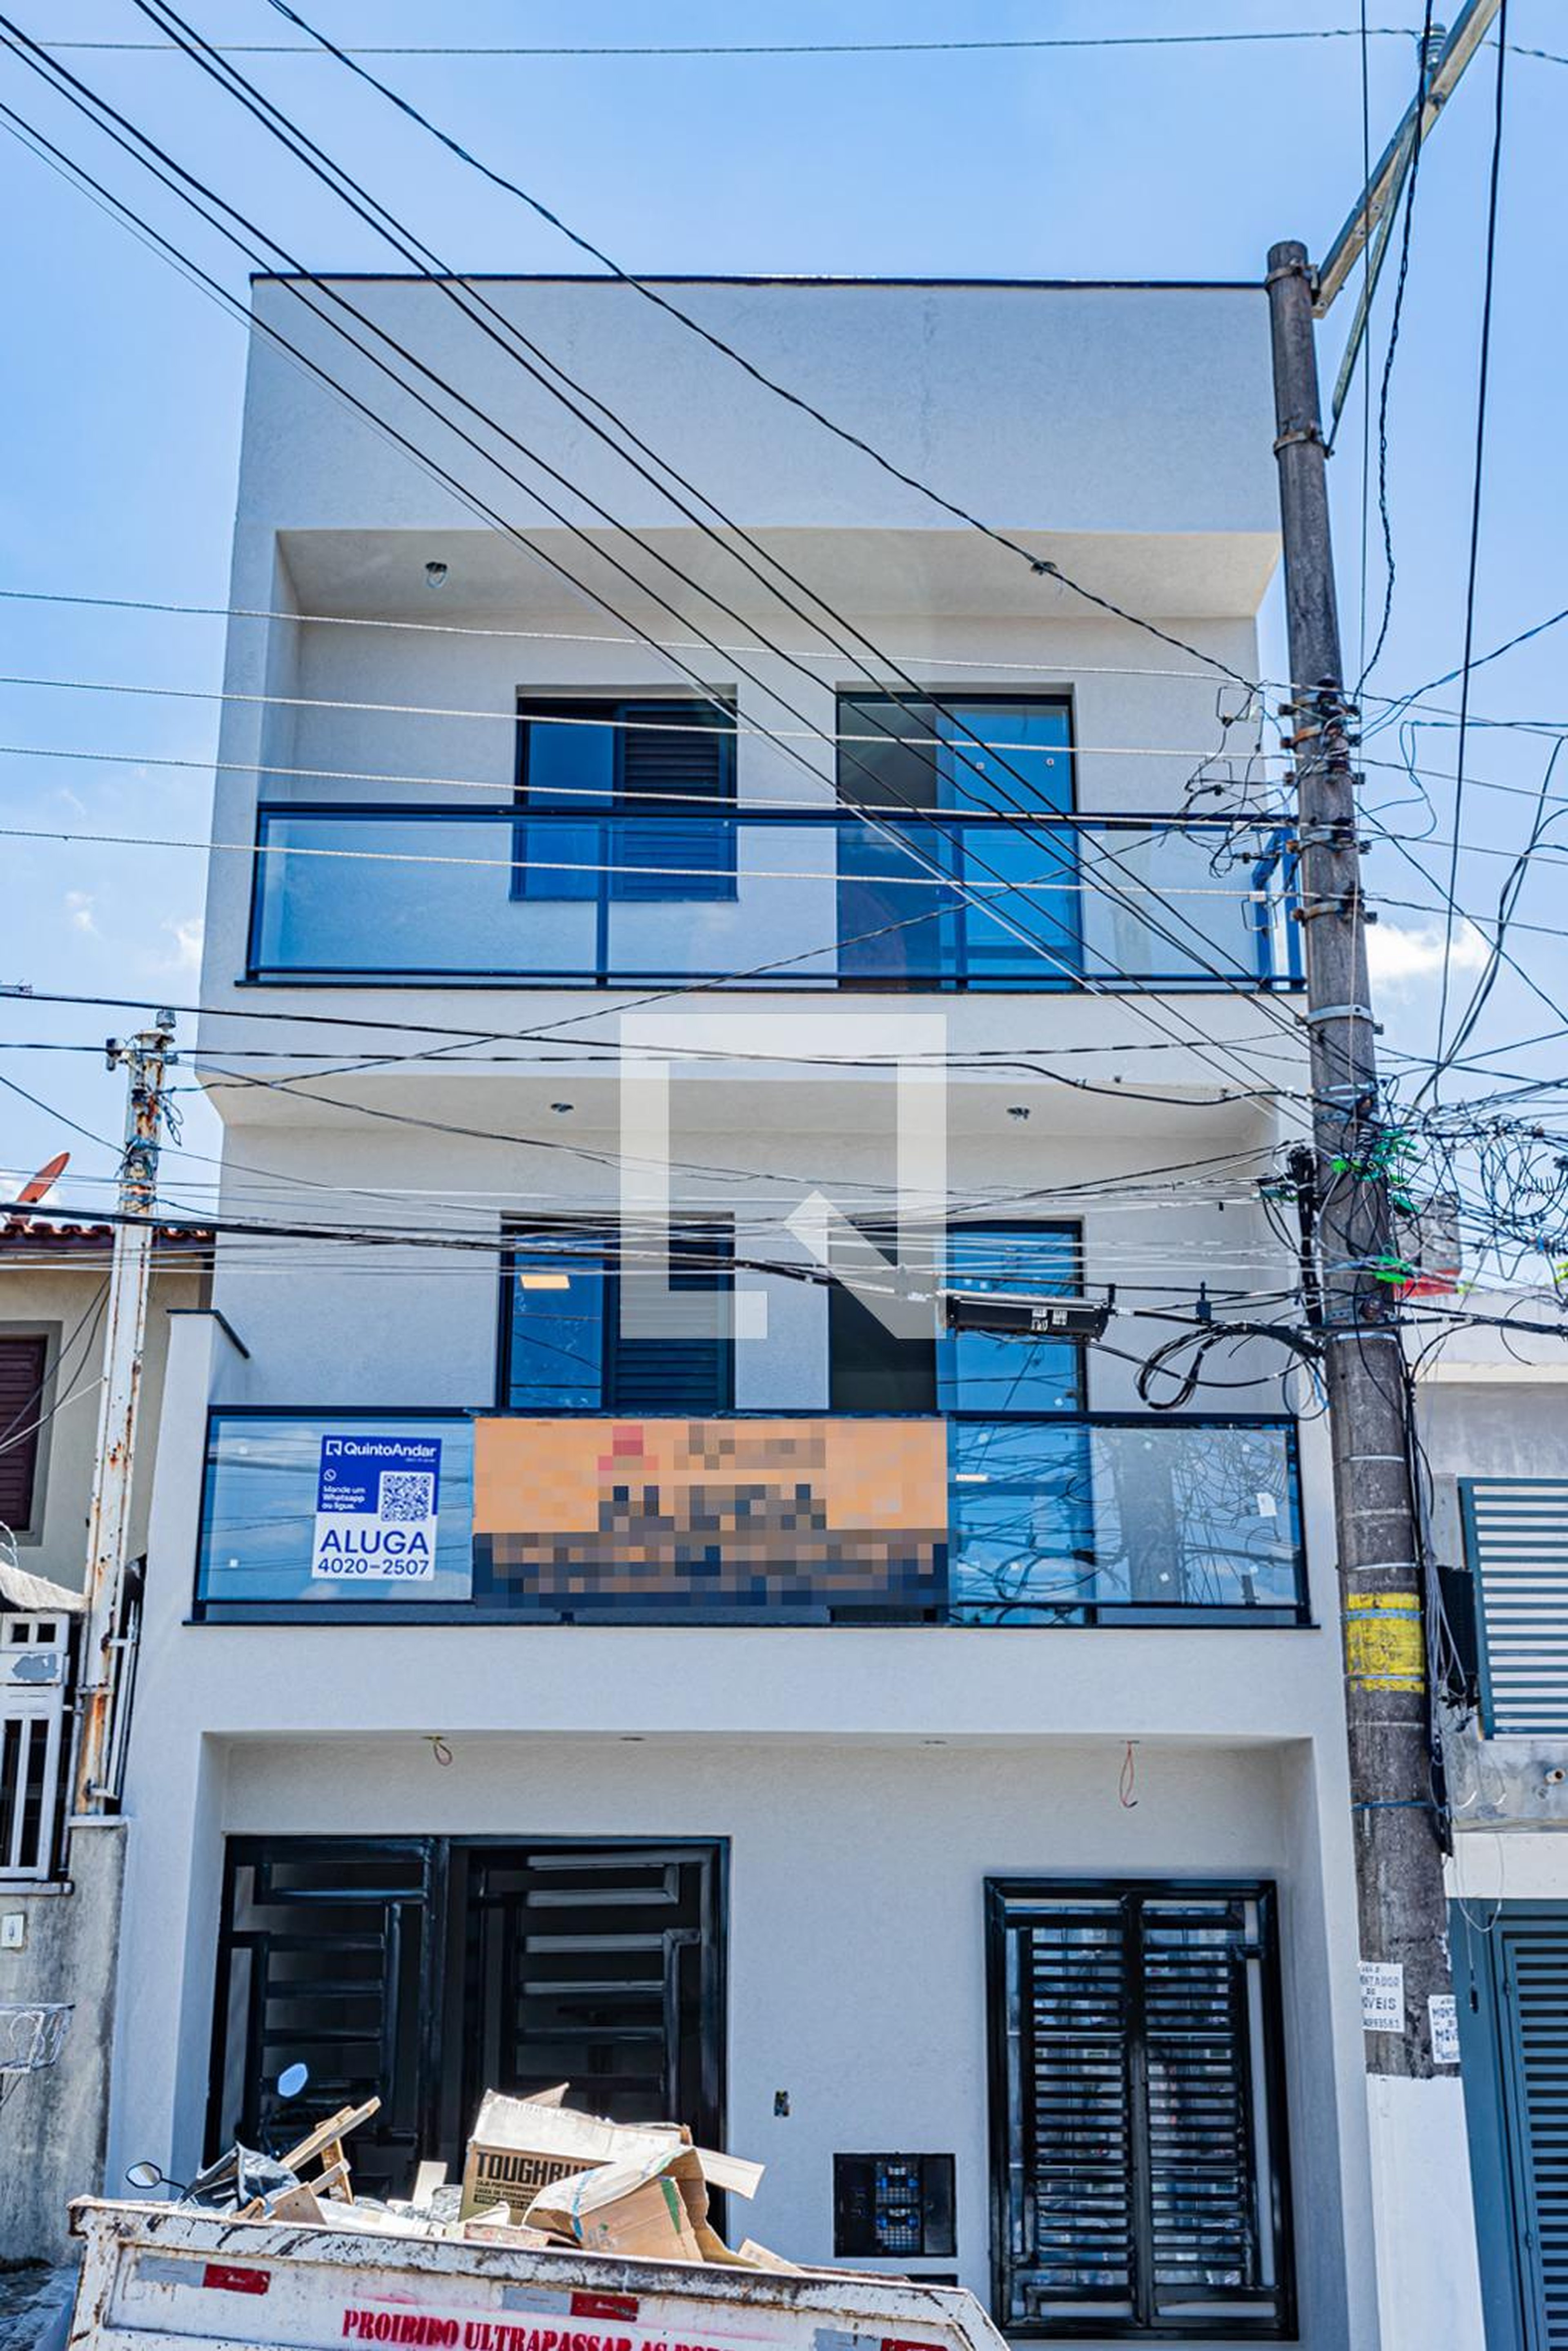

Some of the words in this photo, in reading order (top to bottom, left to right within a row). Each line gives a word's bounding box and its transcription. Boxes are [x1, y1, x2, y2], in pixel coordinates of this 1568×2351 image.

[344, 1441, 437, 1457] QuintoAndar
[320, 1529, 429, 1555] ALUGA
[318, 1558, 429, 1575] 4020-2507
[477, 2151, 595, 2187] TOUGHB
[343, 2309, 459, 2348] PROIBIDO
